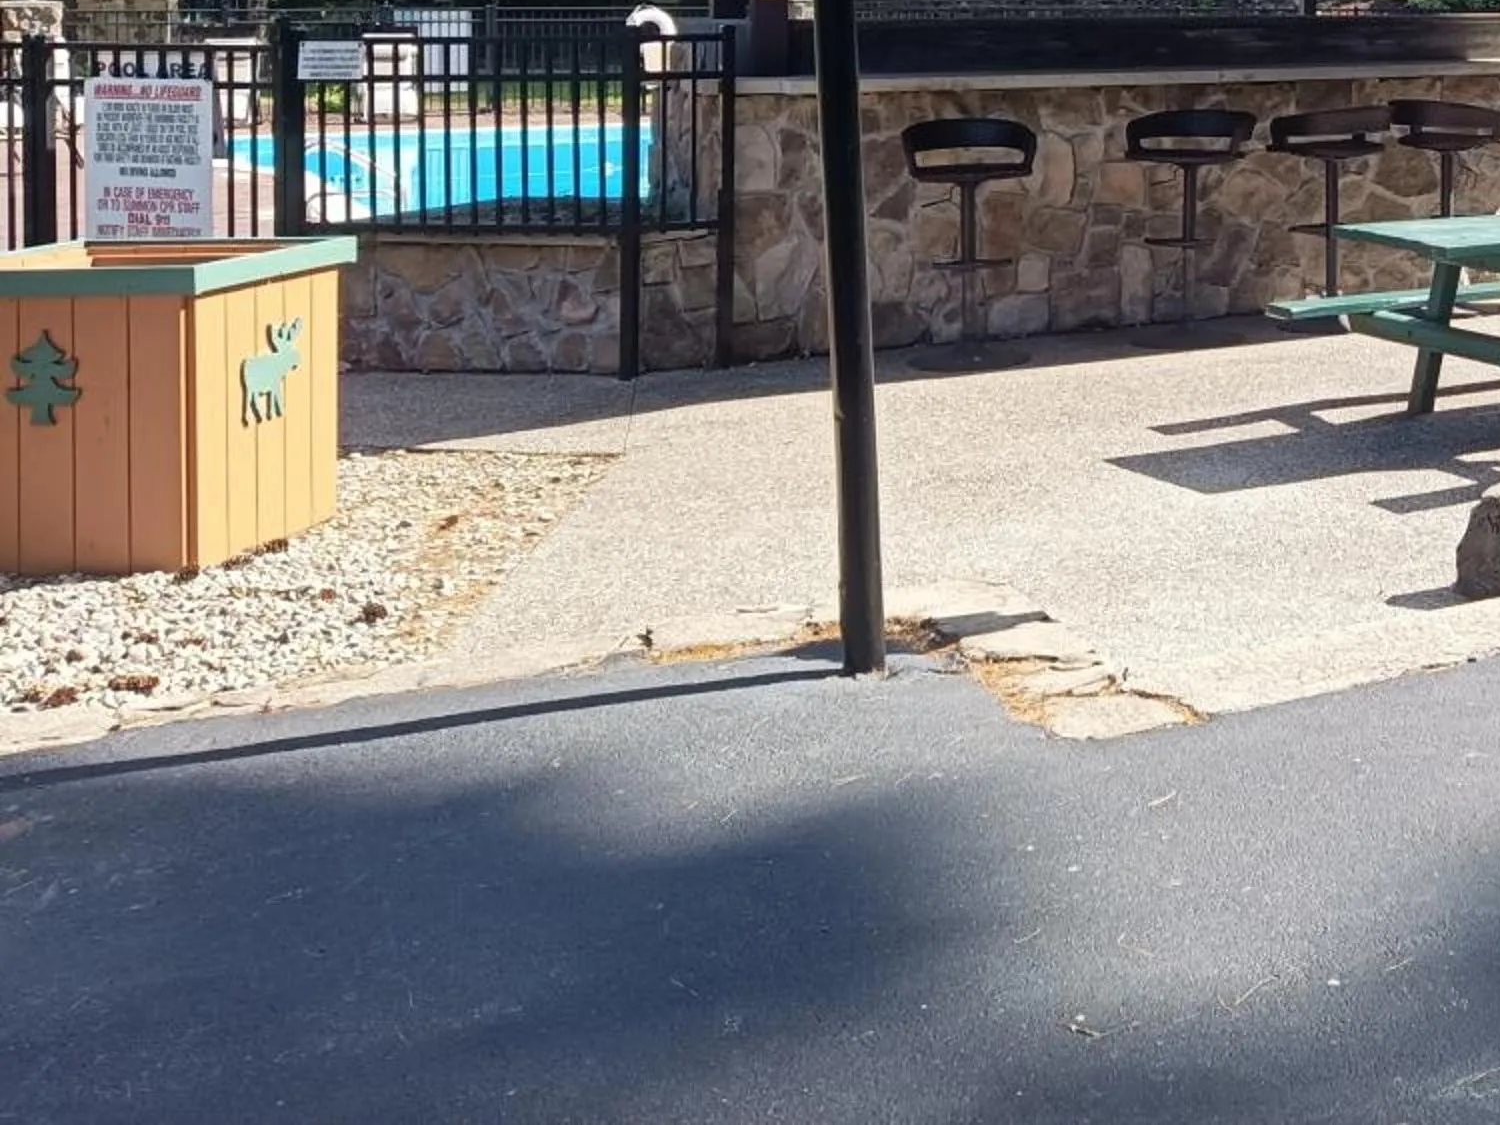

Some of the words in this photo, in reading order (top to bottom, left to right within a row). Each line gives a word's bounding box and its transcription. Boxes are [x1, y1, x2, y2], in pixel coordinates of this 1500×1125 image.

[96, 61, 149, 78] POOL
[156, 62, 212, 80] AREA
[113, 186, 133, 198] CASE
[147, 187, 194, 201] EMERGENCY
